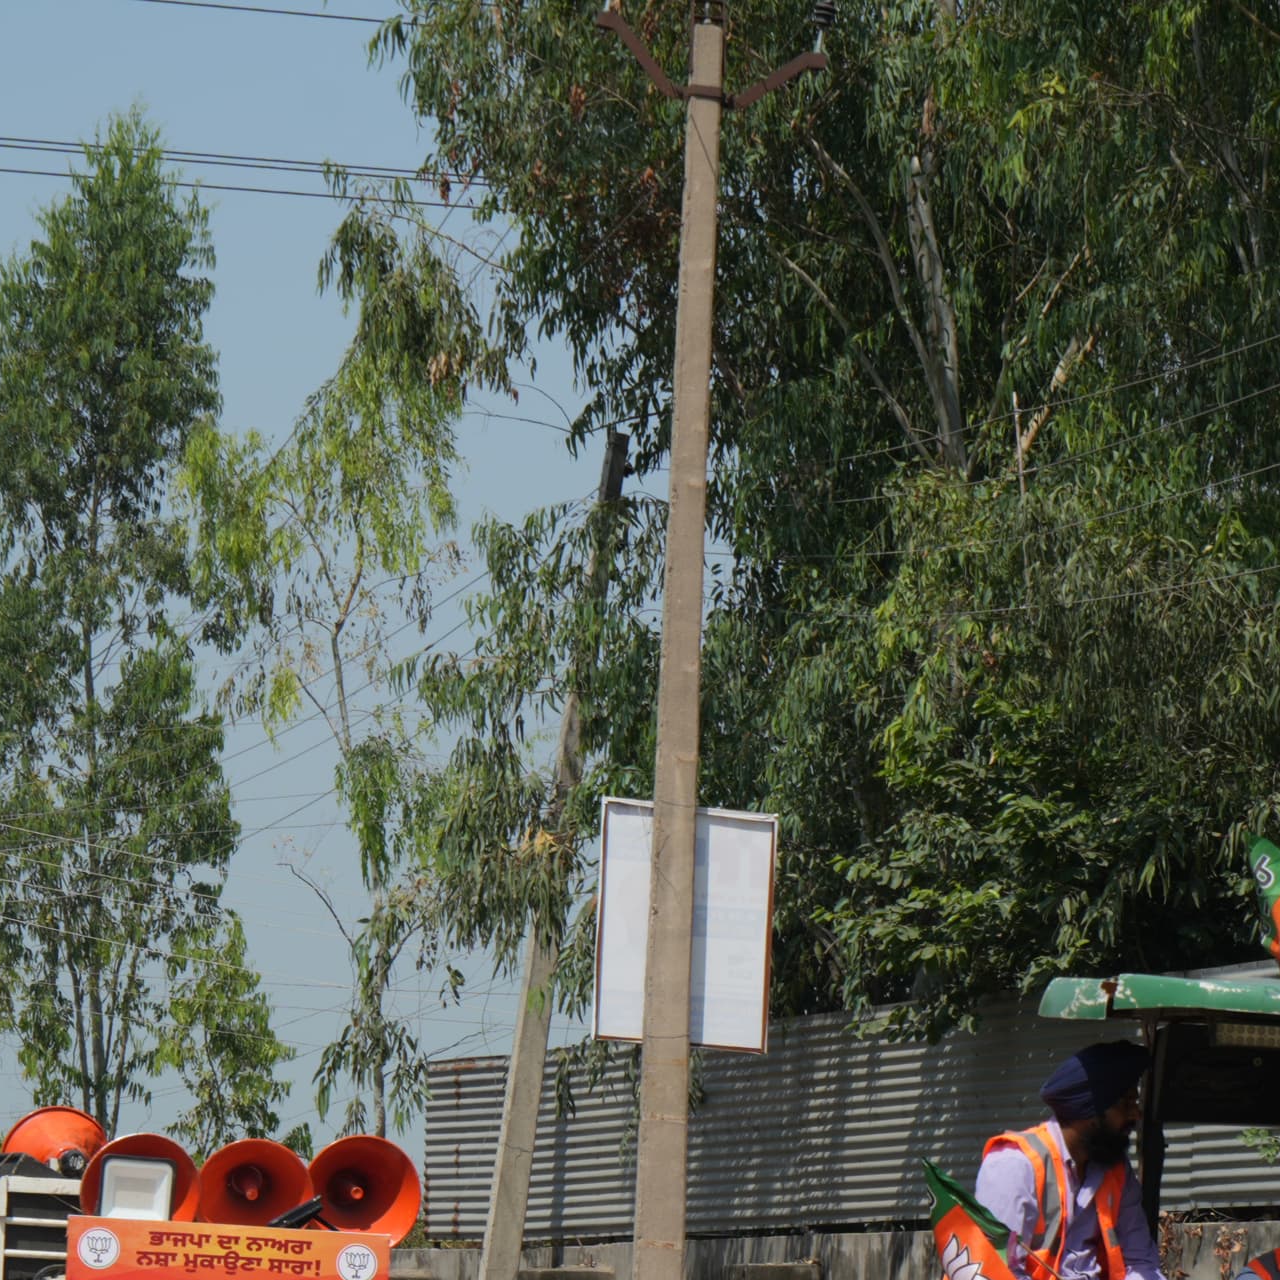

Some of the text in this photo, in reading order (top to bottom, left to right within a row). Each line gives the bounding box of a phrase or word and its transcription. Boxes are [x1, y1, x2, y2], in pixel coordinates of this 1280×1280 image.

[148, 1229, 313, 1256] ਭਾਜਪਾ ਦਾ ਨਾਅਰਾ
[135, 1249, 321, 1277] ਨਸ਼ਾ ਮੁਕਾਉਣਾ ਸਾਰਾ!
